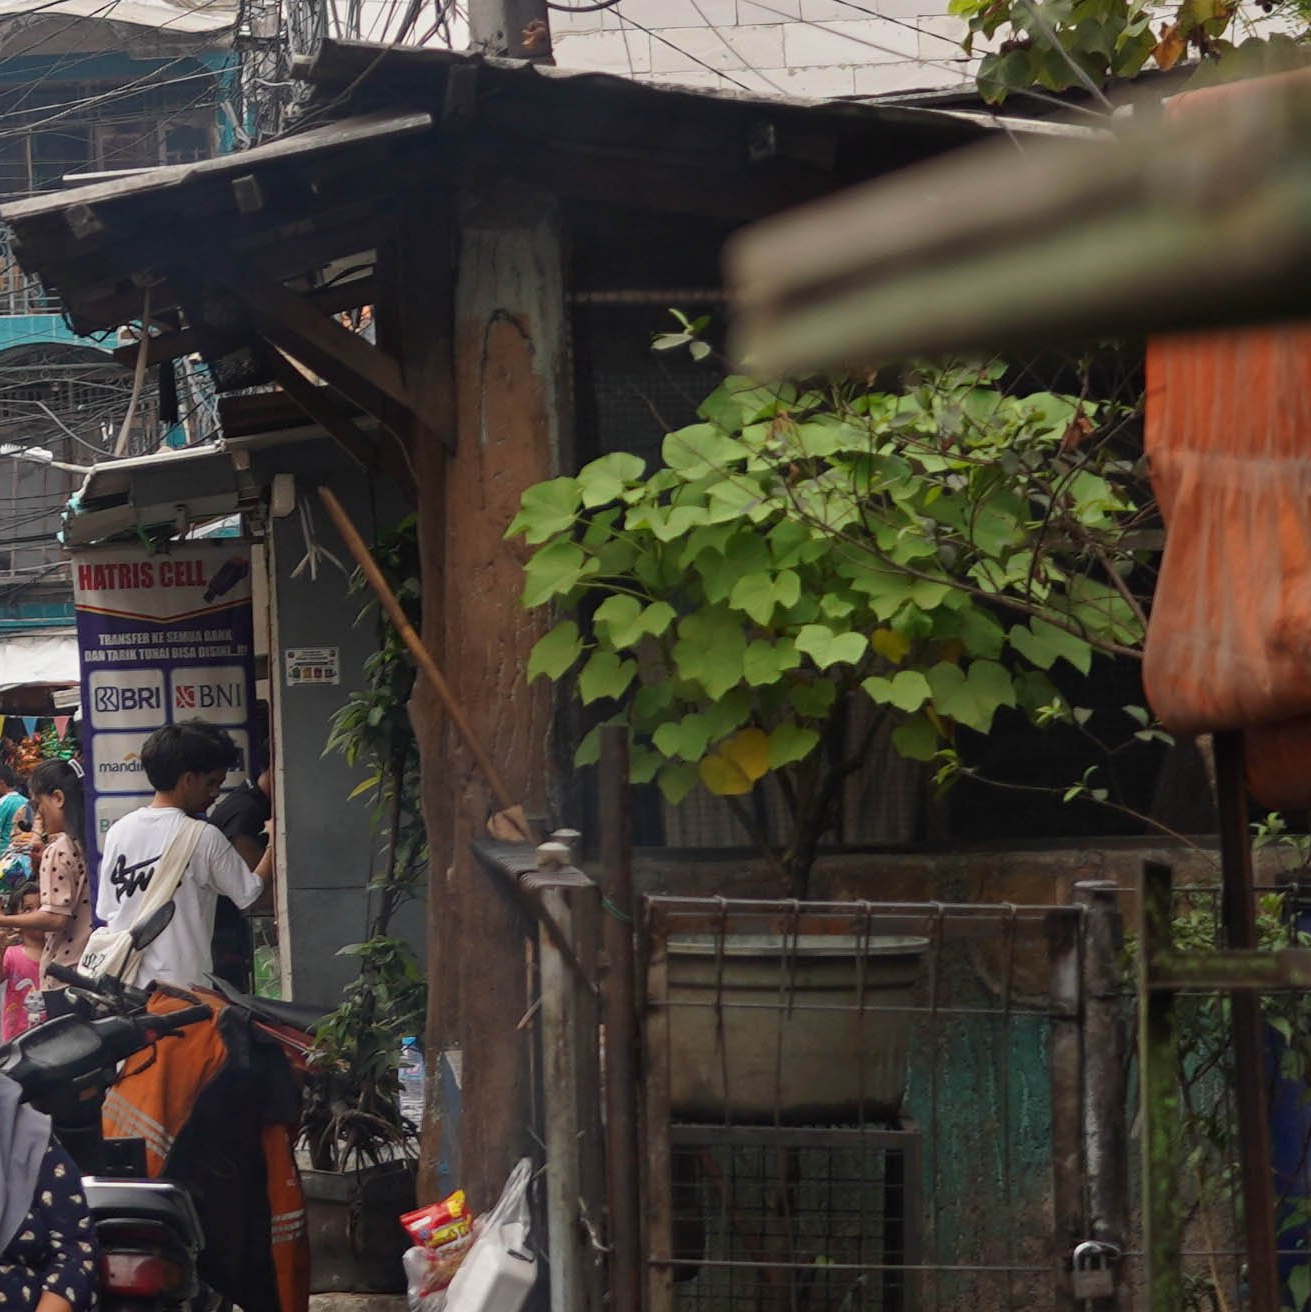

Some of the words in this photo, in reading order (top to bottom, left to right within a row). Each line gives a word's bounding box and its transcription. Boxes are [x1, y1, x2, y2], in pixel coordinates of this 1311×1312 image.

[78, 561, 154, 590] HATRIS
[159, 560, 207, 588] CELL
[98, 632, 151, 646] TRANSFER
[166, 631, 203, 644] SEMUA
[204, 629, 233, 642] BANK
[84, 650, 106, 663] DAN
[107, 648, 138, 662] TARIK
[139, 647, 171, 660] TUNAI
[172, 646, 197, 659] BISA
[121, 687, 161, 710] BRI
[199, 684, 242, 708] BNI
[99, 760, 144, 773] mandi
